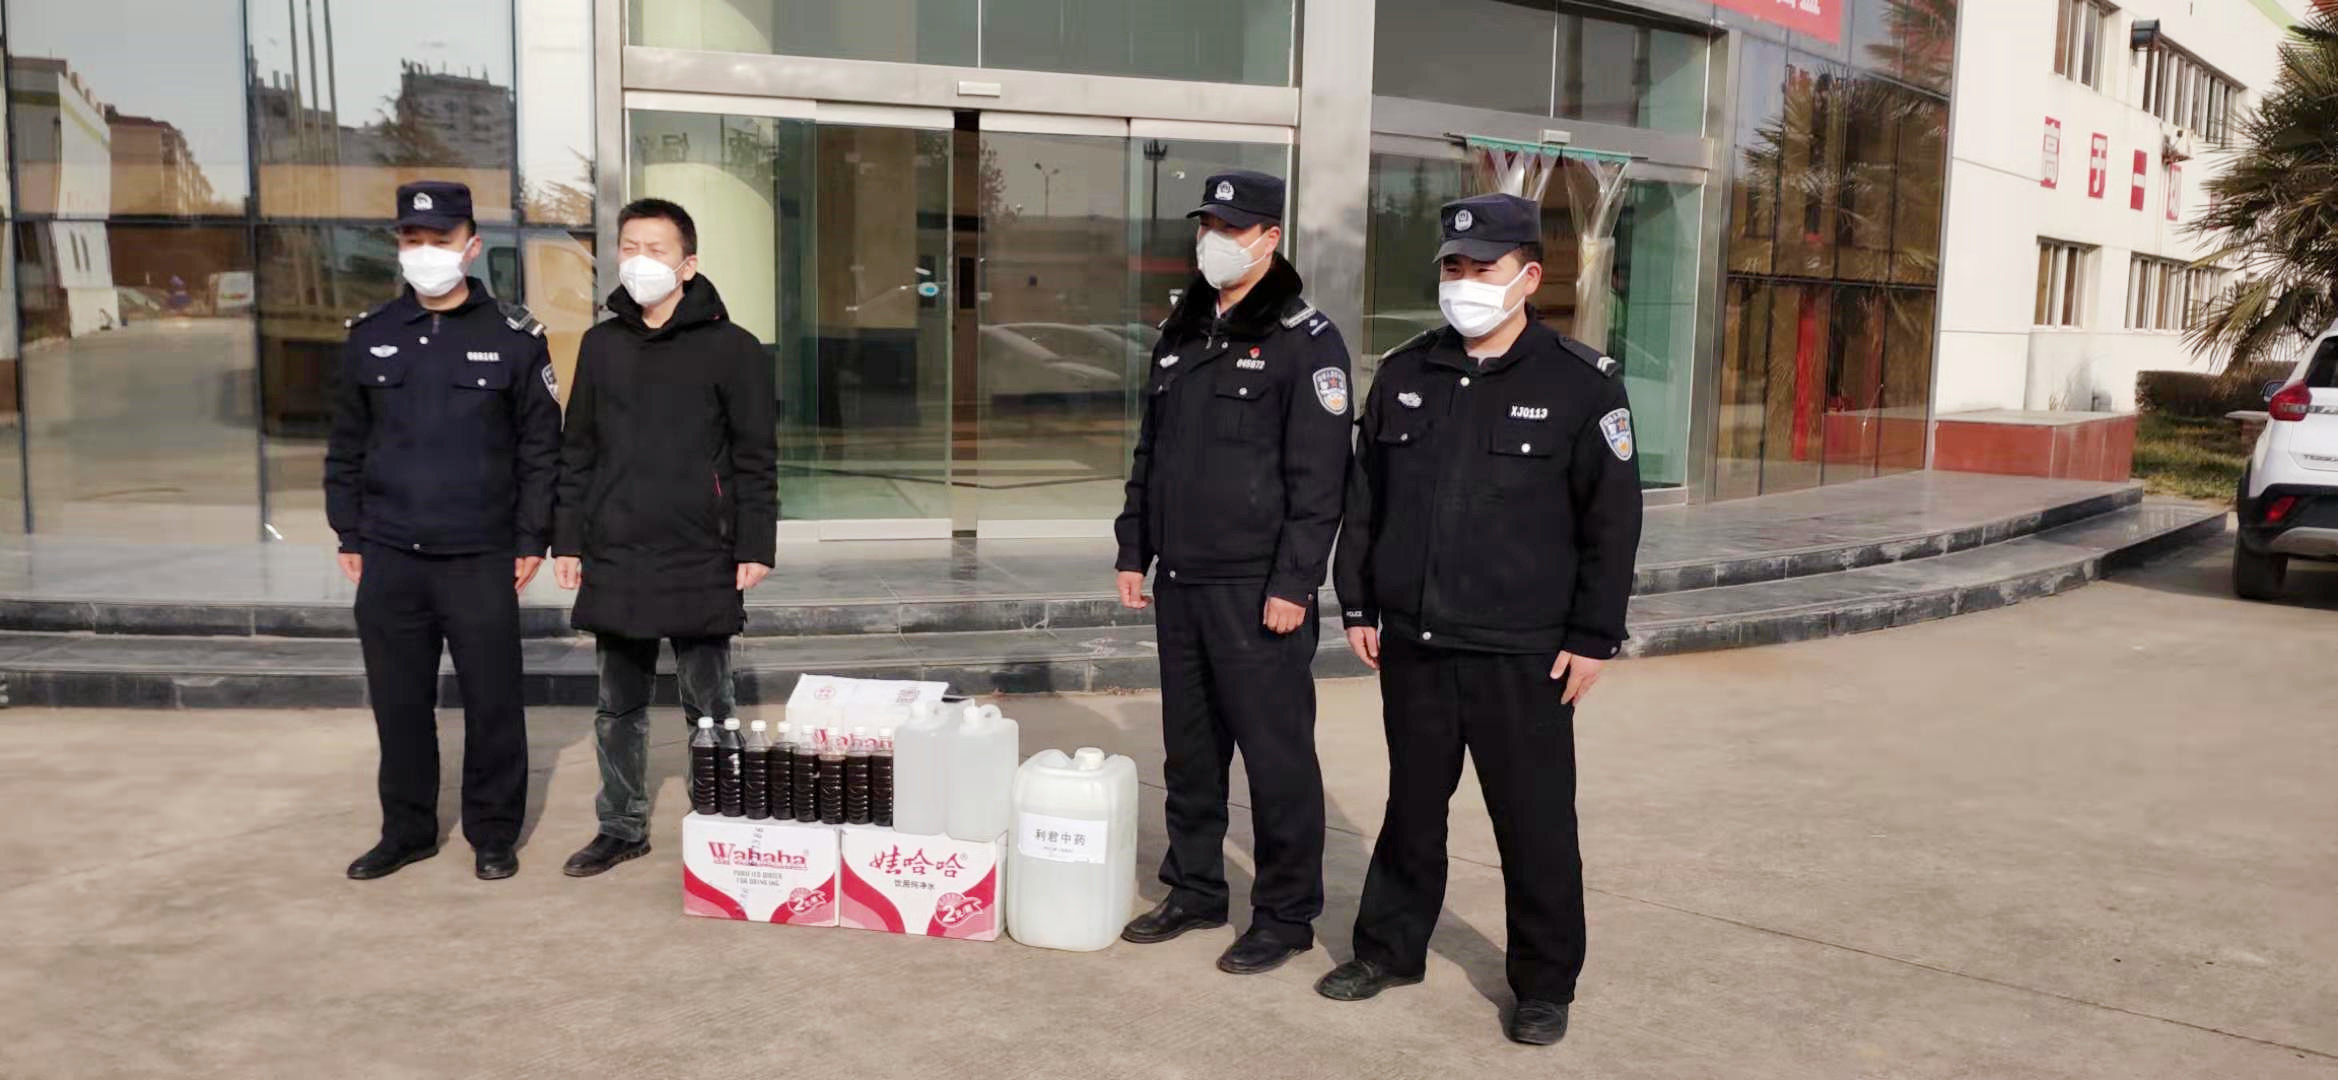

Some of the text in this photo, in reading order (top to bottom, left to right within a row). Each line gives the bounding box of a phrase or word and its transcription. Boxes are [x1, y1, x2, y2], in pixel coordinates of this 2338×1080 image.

[1510, 405, 1548, 419] XJ0113
[1035, 828, 1086, 846] 利君中药
[708, 841, 807, 865] Wahaha
[868, 844, 966, 878] 娃哈哈
